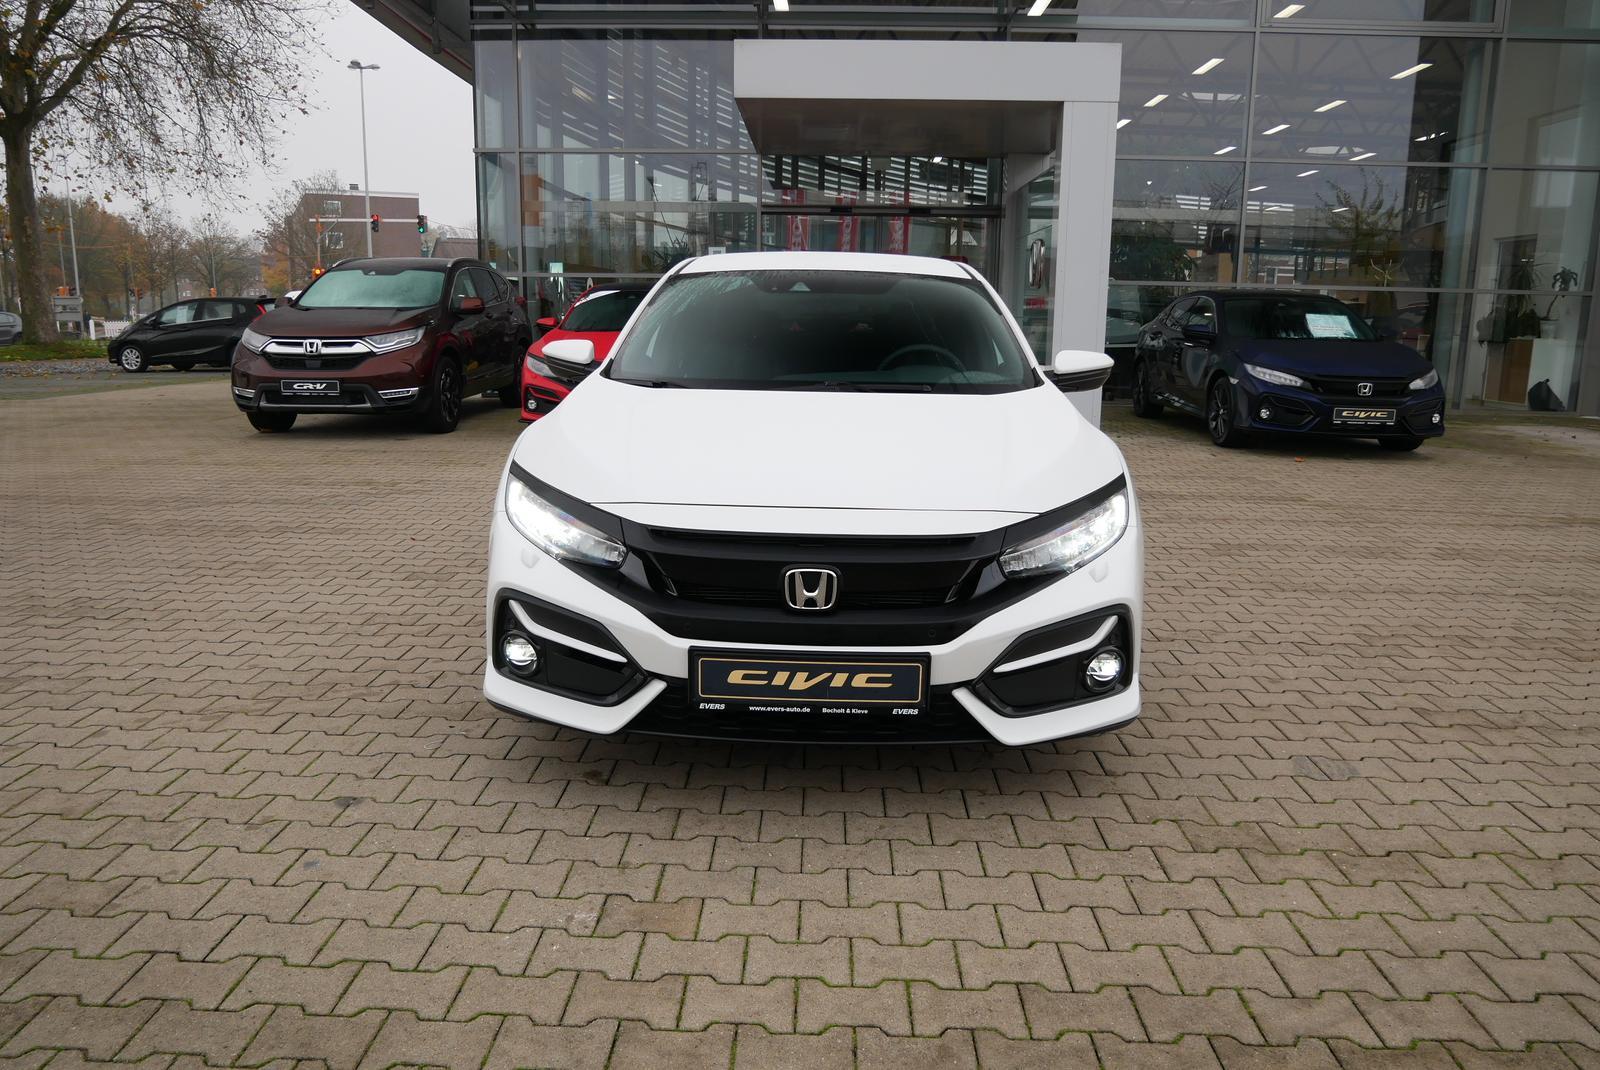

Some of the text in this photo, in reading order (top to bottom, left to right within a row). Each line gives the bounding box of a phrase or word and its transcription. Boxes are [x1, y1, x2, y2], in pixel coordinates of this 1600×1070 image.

[1342, 410, 1388, 418] CIVIC
[727, 669, 893, 691] CIVIC
[699, 702, 726, 710] EVERS
[748, 705, 811, 713] www.evers-auto.de
